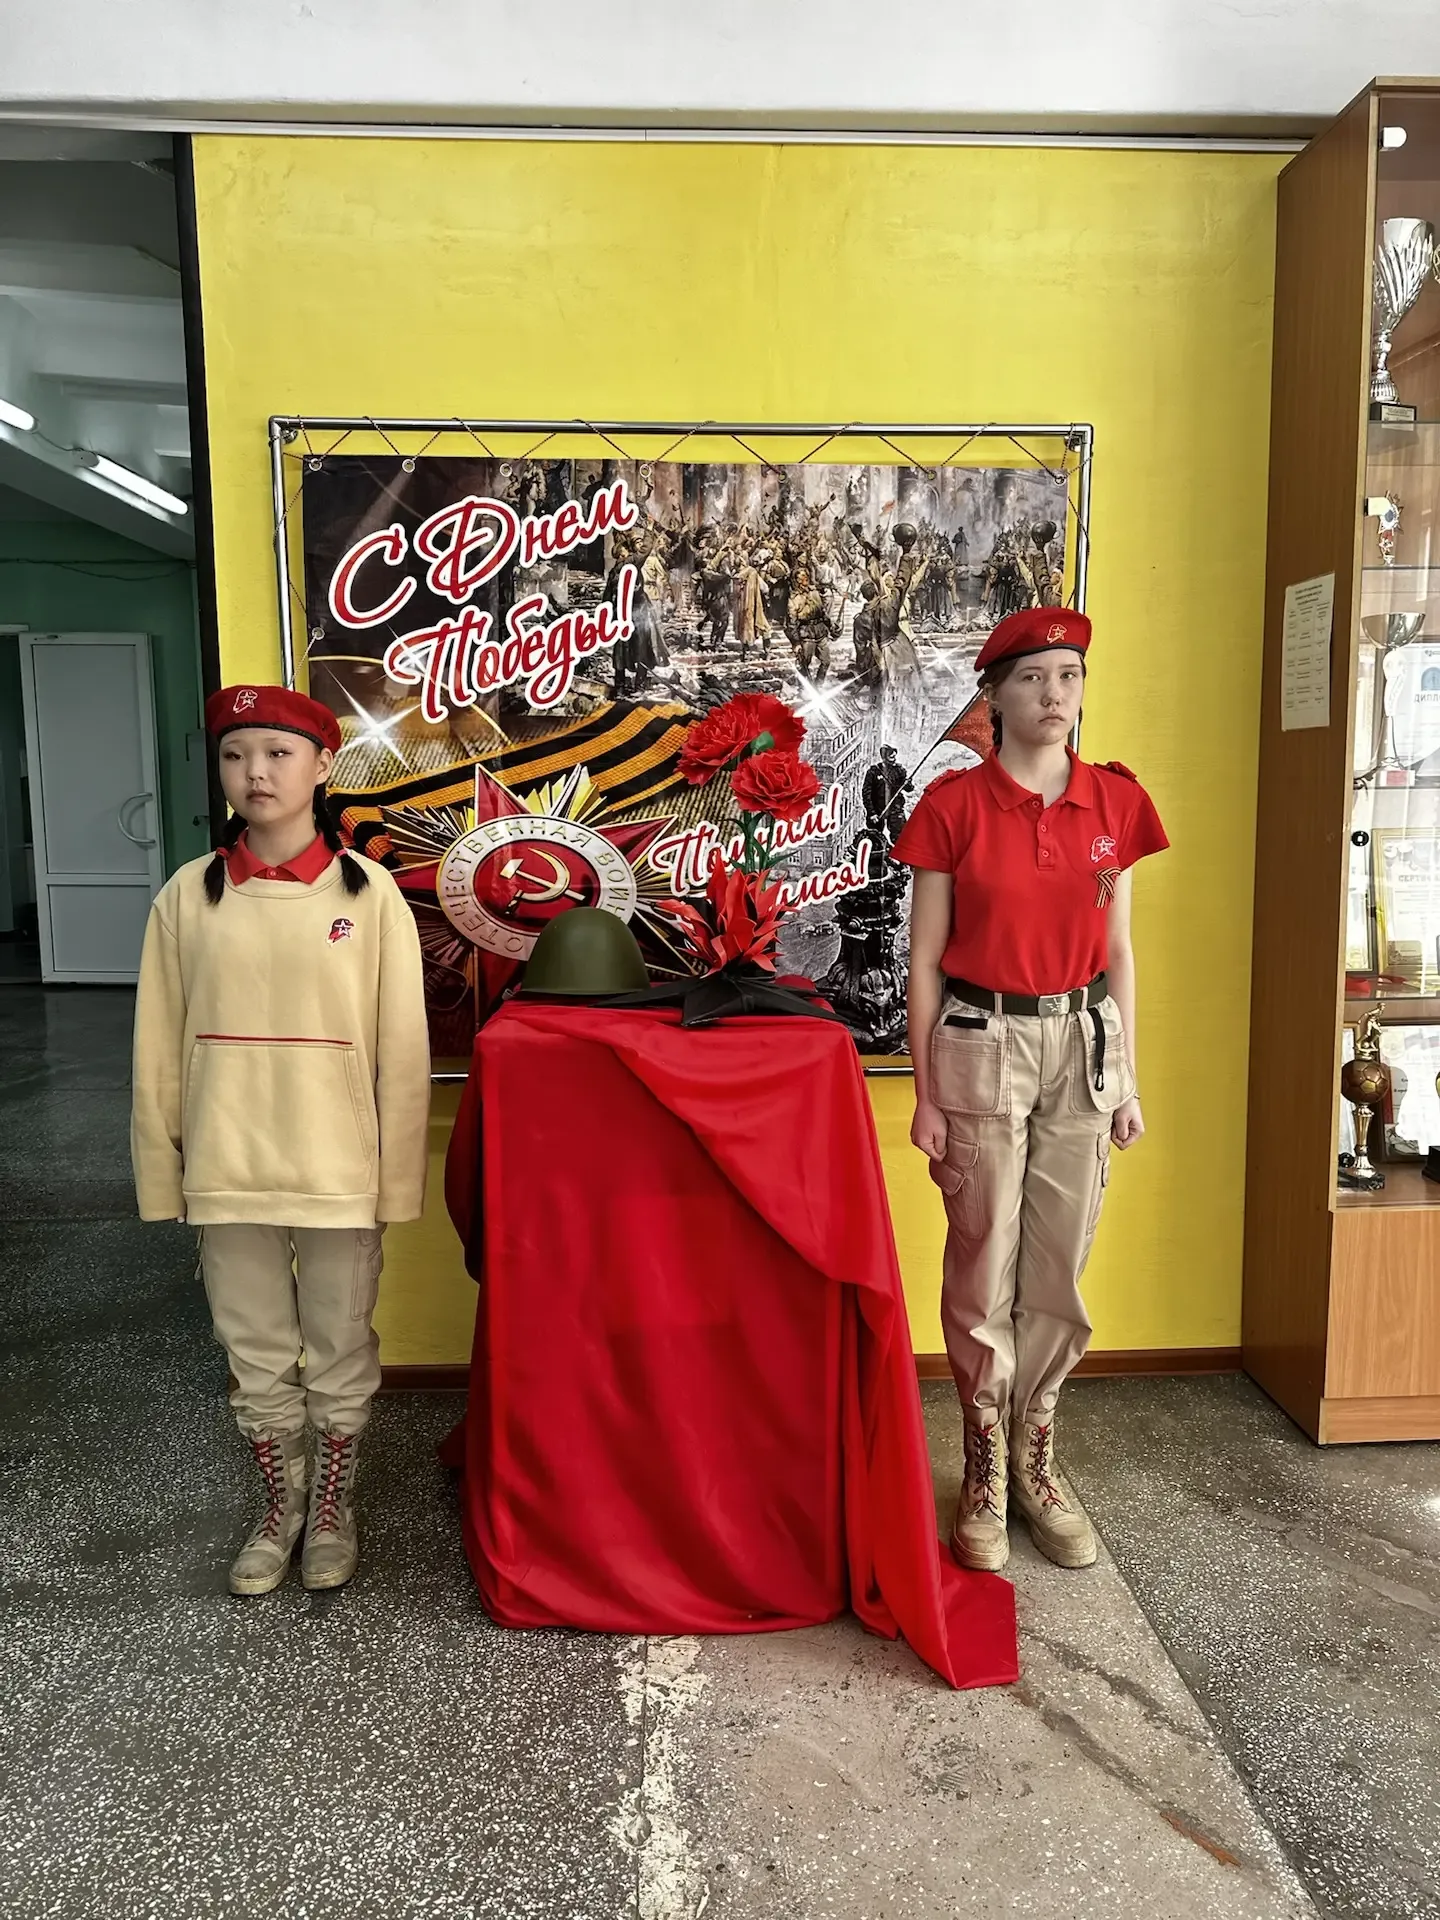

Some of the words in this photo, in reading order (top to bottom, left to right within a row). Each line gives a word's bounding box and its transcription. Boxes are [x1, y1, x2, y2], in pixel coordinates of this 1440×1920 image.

[331, 525, 414, 627] С
[416, 482, 637, 602] Днем
[385, 567, 637, 721] Победы!
[1414, 693, 1440, 704] ДИПЛ
[444, 819, 593, 953] ОТЕЧЕСТВЕННАЯ
[593, 850, 631, 920] ВОЙН
